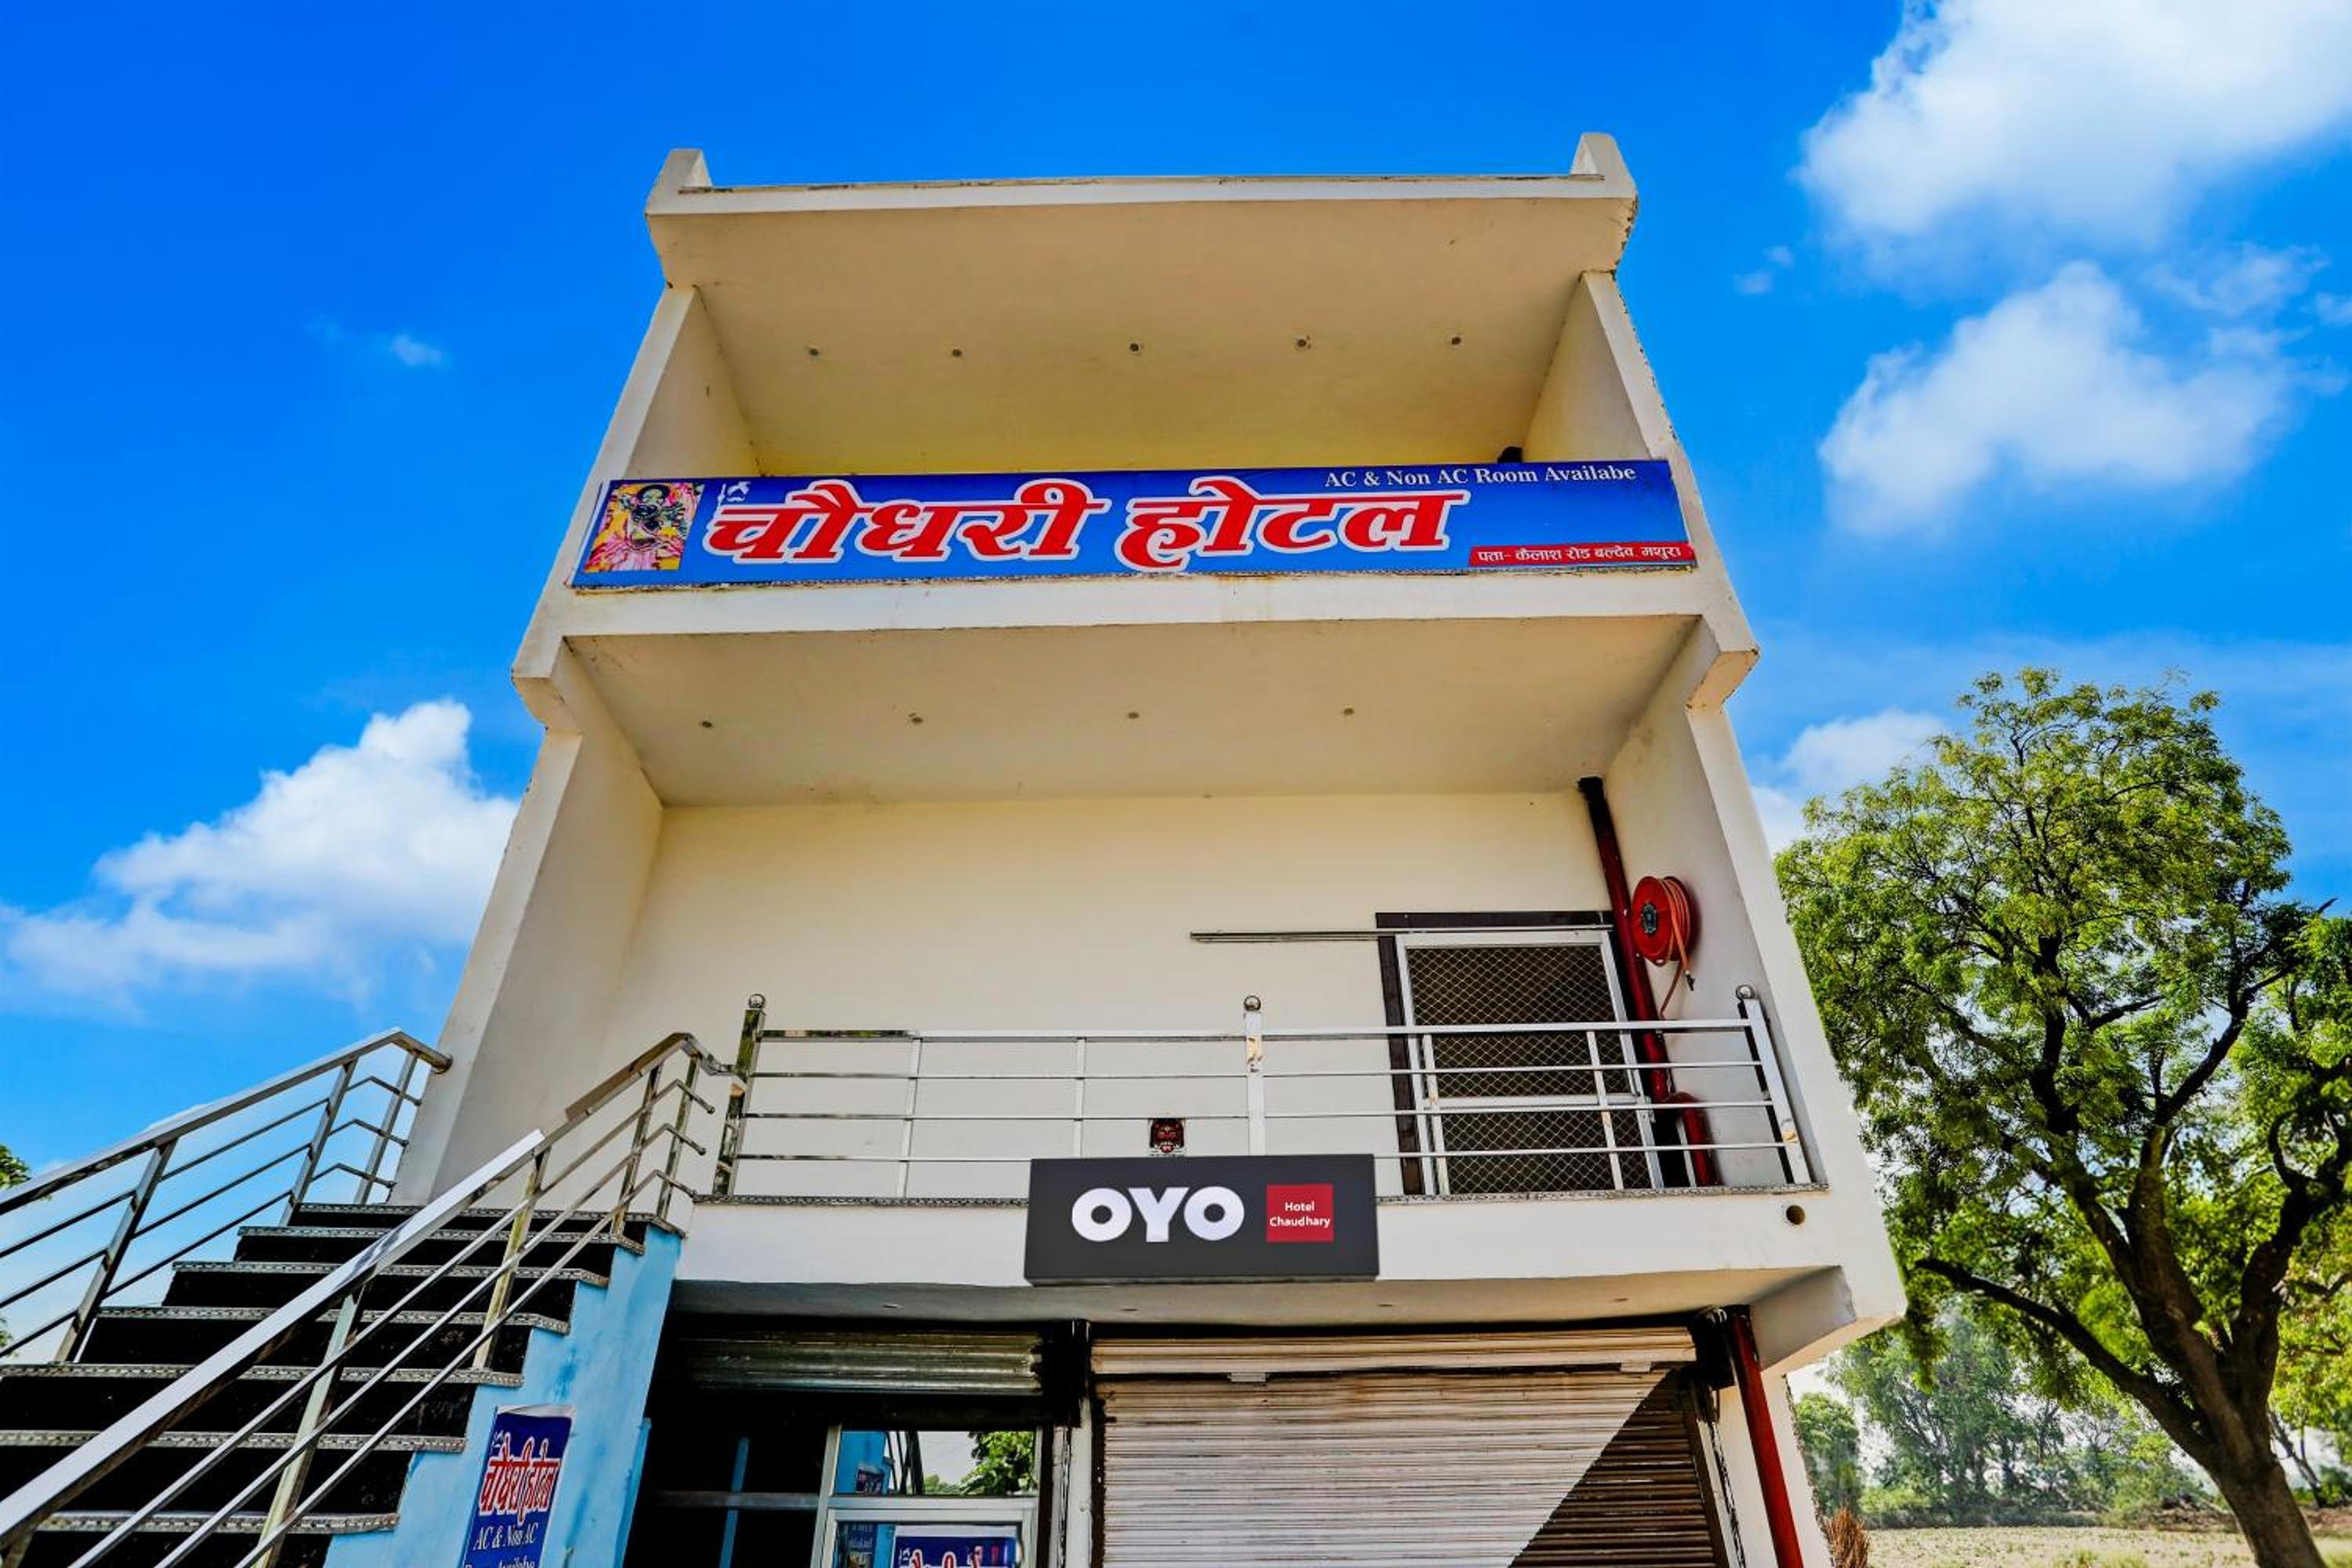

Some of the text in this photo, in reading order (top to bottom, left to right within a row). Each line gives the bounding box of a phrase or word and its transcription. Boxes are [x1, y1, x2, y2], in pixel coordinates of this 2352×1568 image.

[1325, 465, 1636, 487] AC & Non AC Room Availabe
[706, 476, 1468, 572] चौधरी होटल
[1072, 1186, 1245, 1243] OYO
[1284, 1200, 1315, 1211] Hotel
[1269, 1215, 1330, 1229] Chaudhary
